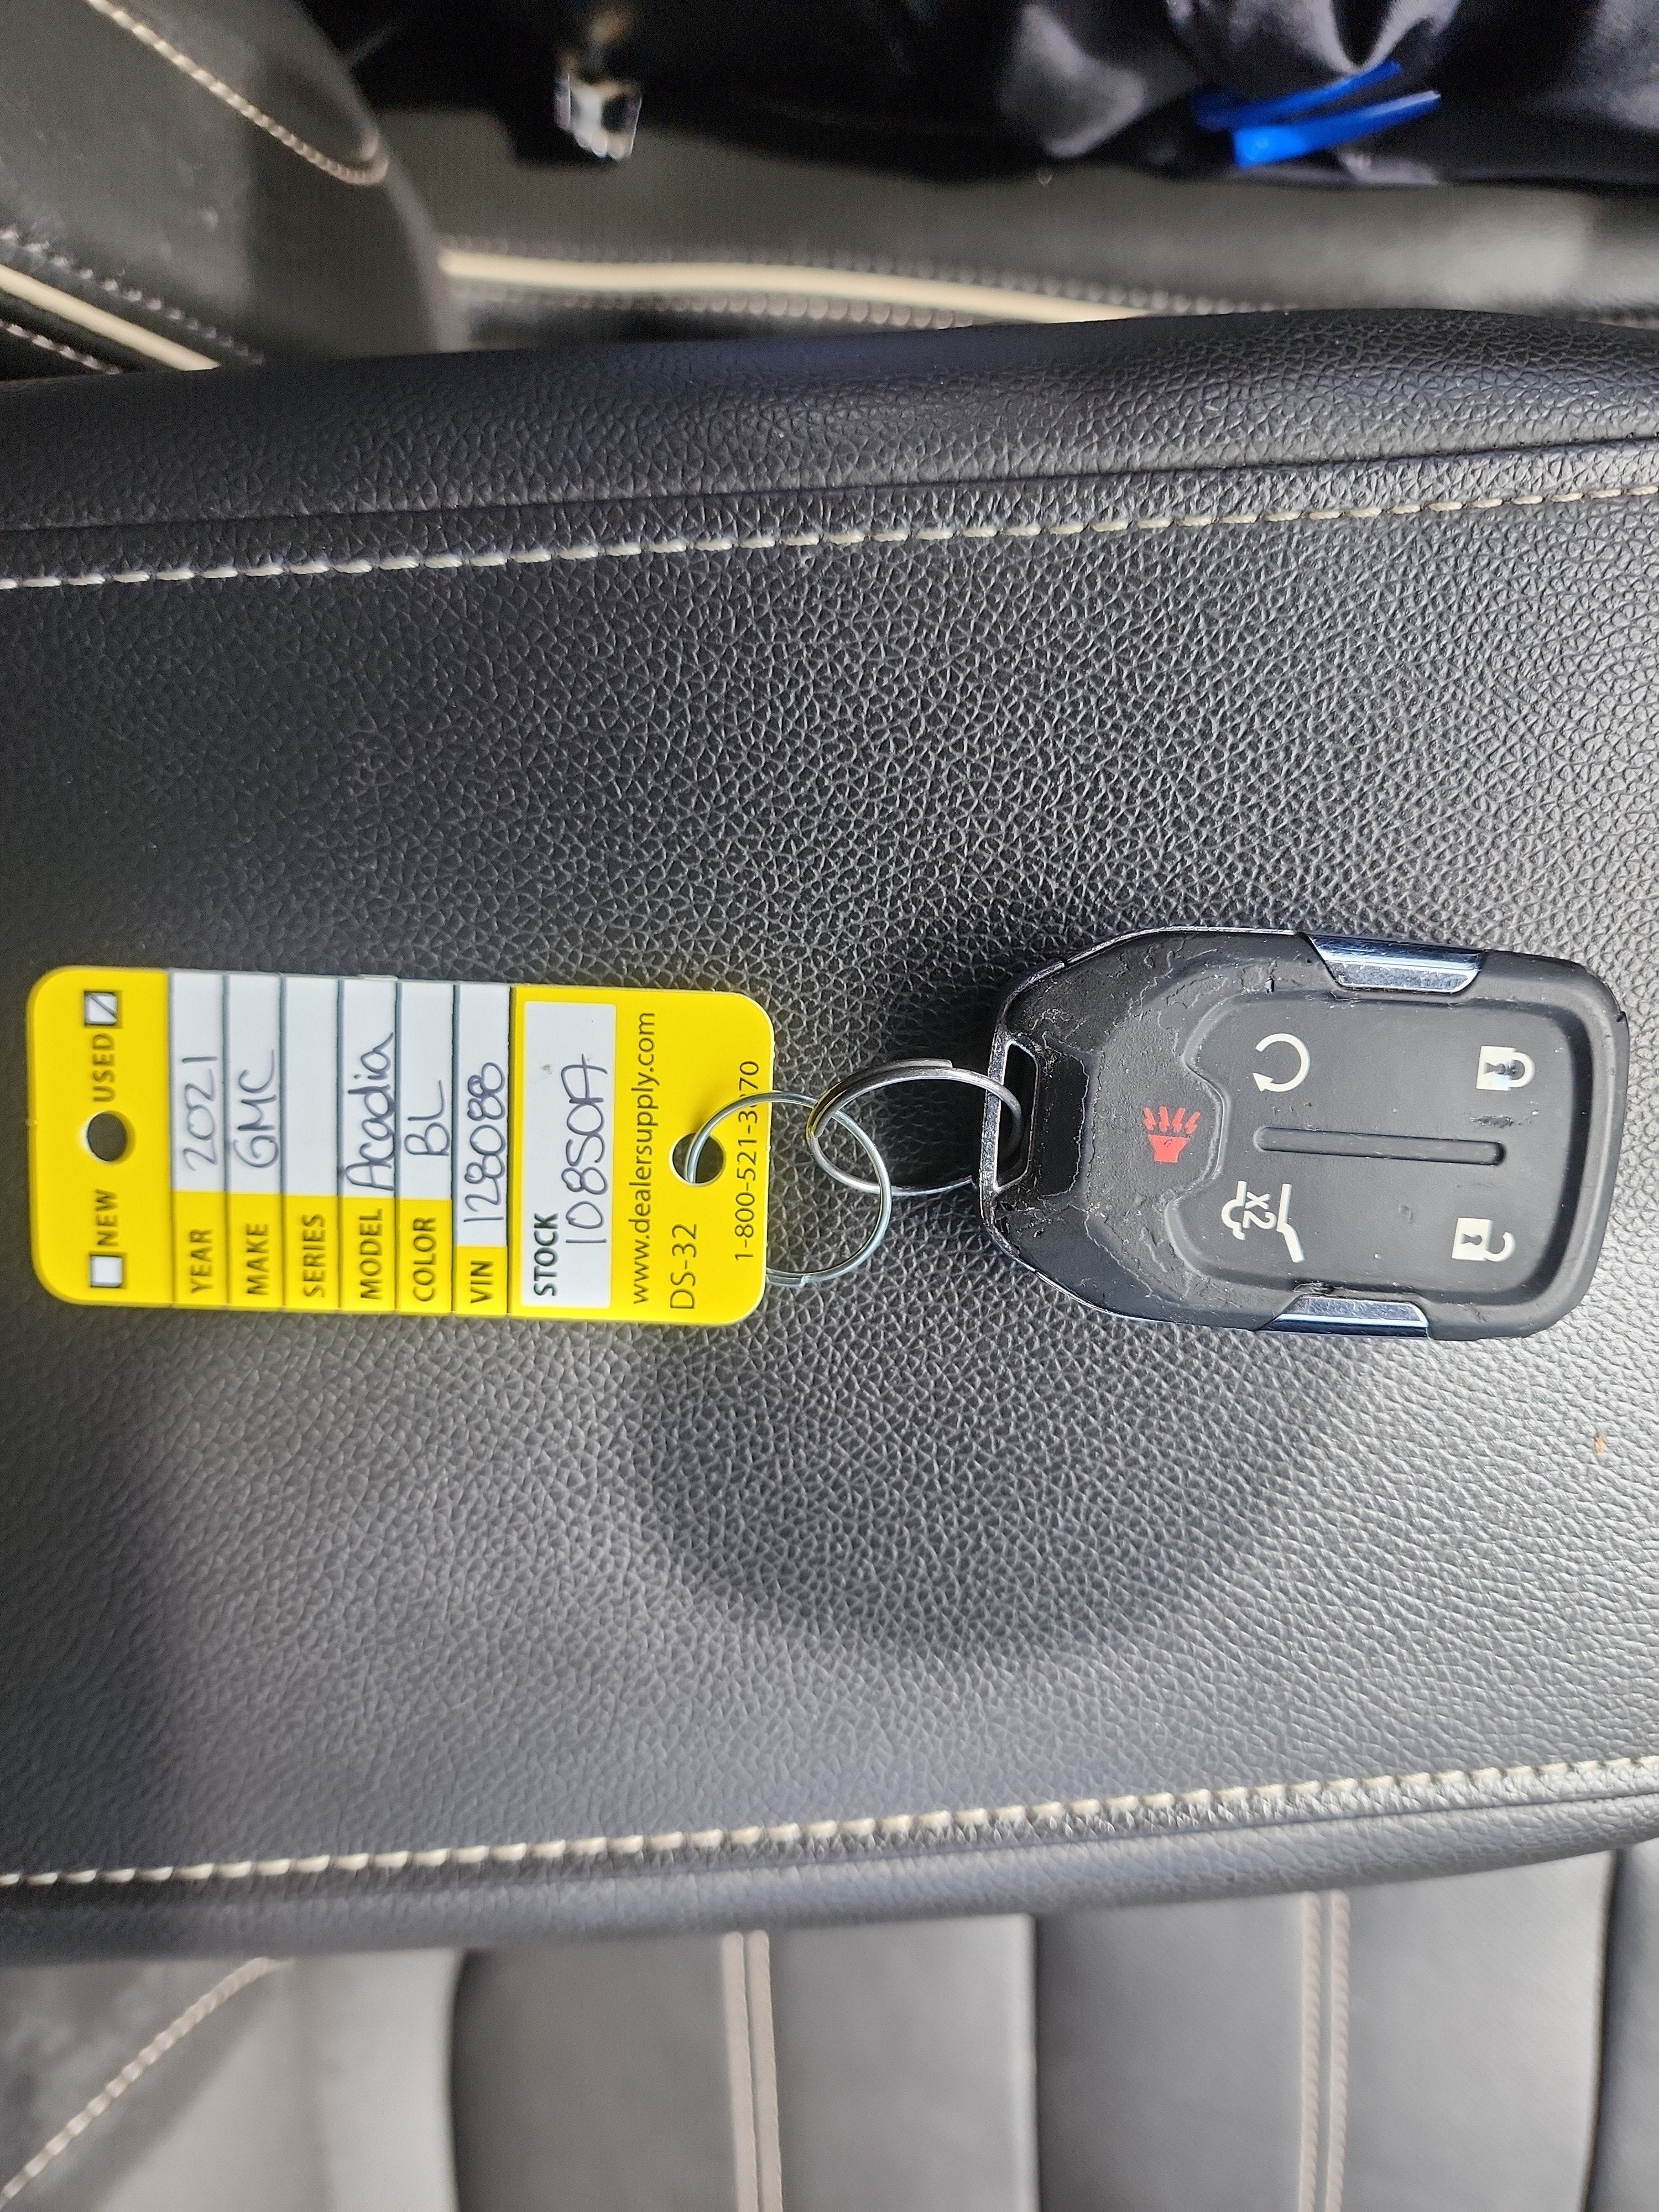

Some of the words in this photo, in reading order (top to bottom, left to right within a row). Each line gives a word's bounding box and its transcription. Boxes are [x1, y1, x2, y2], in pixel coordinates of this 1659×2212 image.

[92, 1033, 116, 1102] USED
[233, 1049, 279, 1168] GMC
[181, 1056, 218, 1171] 2021
[343, 1032, 395, 1191] Acadia
[405, 1079, 450, 1156] BL
[463, 1062, 506, 1223] 128088
[629, 1012, 660, 1305] www.dealersupply.com
[735, 1060, 760, 1262] 1-800-521-370
[95, 1190, 118, 1246] NEW
[190, 1229, 213, 1293] YEAR
[247, 1223, 269, 1295] MAKE
[303, 1213, 326, 1298] SERIES
[360, 1208, 383, 1300] MODEL
[413, 1216, 437, 1302] COLOR
[533, 1212, 559, 1296] STOCK
[470, 1260, 494, 1304] VIN
[670, 1223, 697, 1310] DS-32
